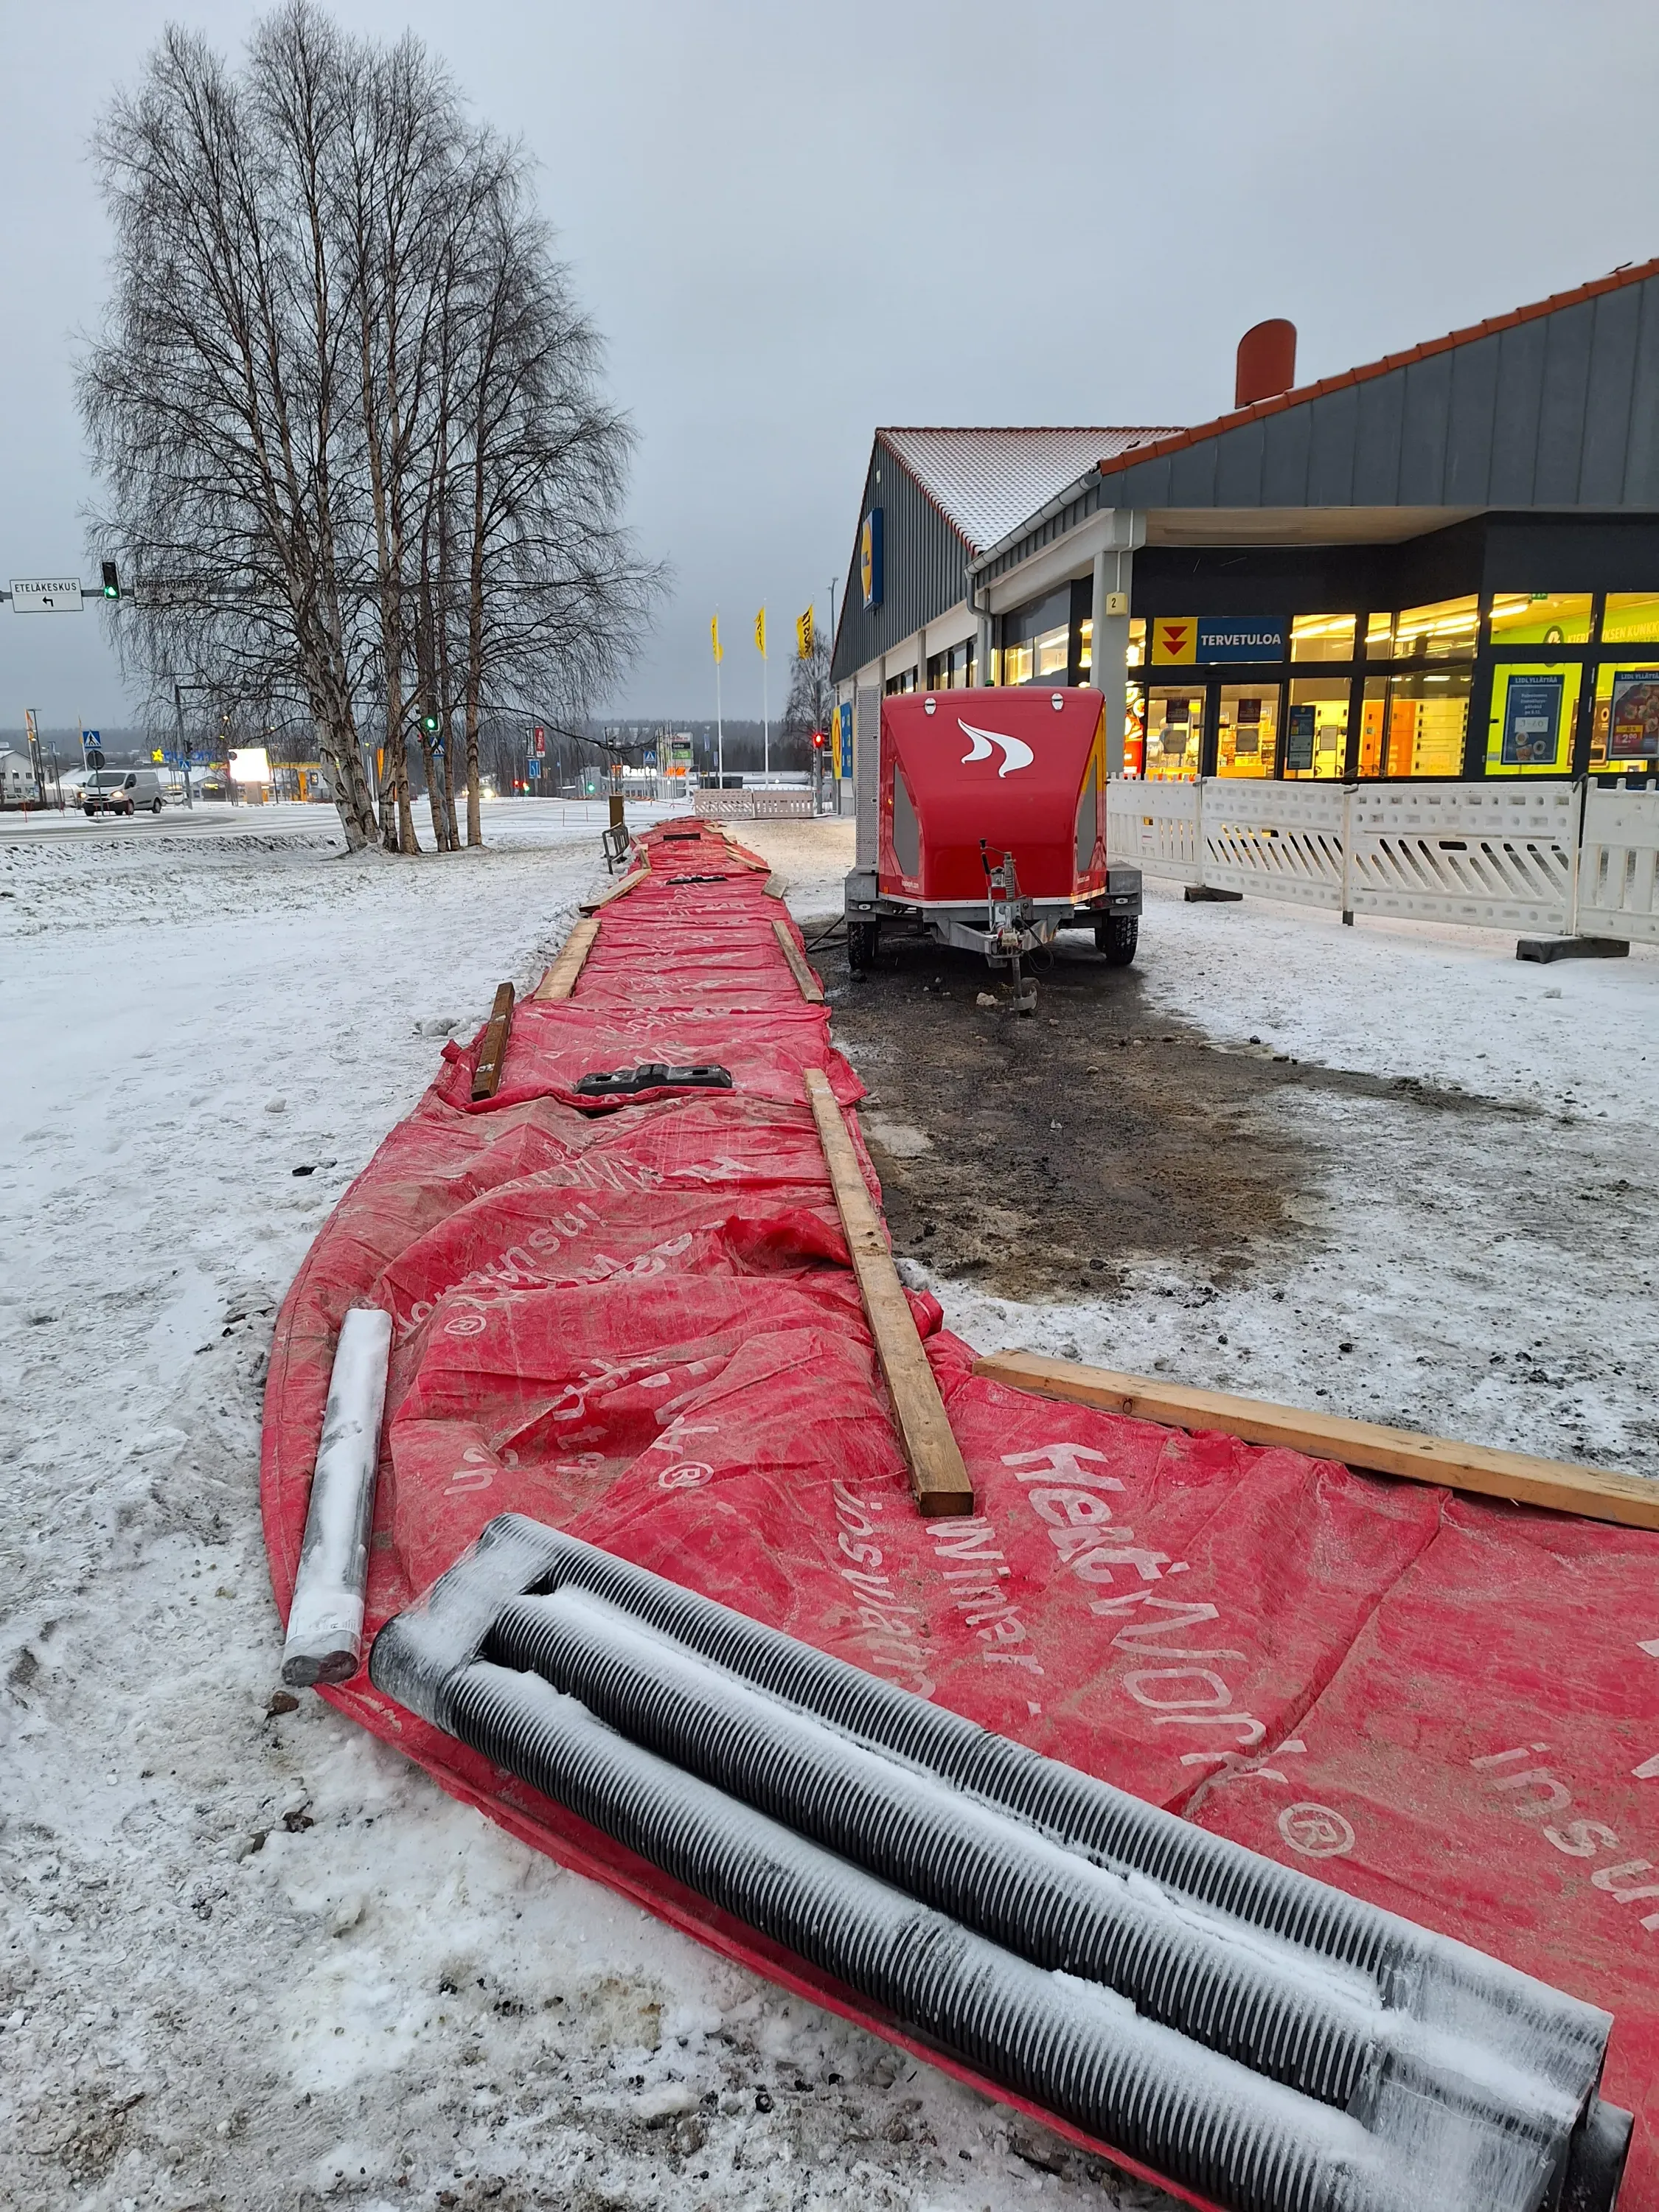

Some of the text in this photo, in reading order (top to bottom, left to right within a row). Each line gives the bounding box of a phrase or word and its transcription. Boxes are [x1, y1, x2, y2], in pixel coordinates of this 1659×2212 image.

[15, 582, 77, 593] ETELÄKESKUS
[1111, 597, 1117, 608] 2
[1201, 633, 1281, 647] TERVETULOA
